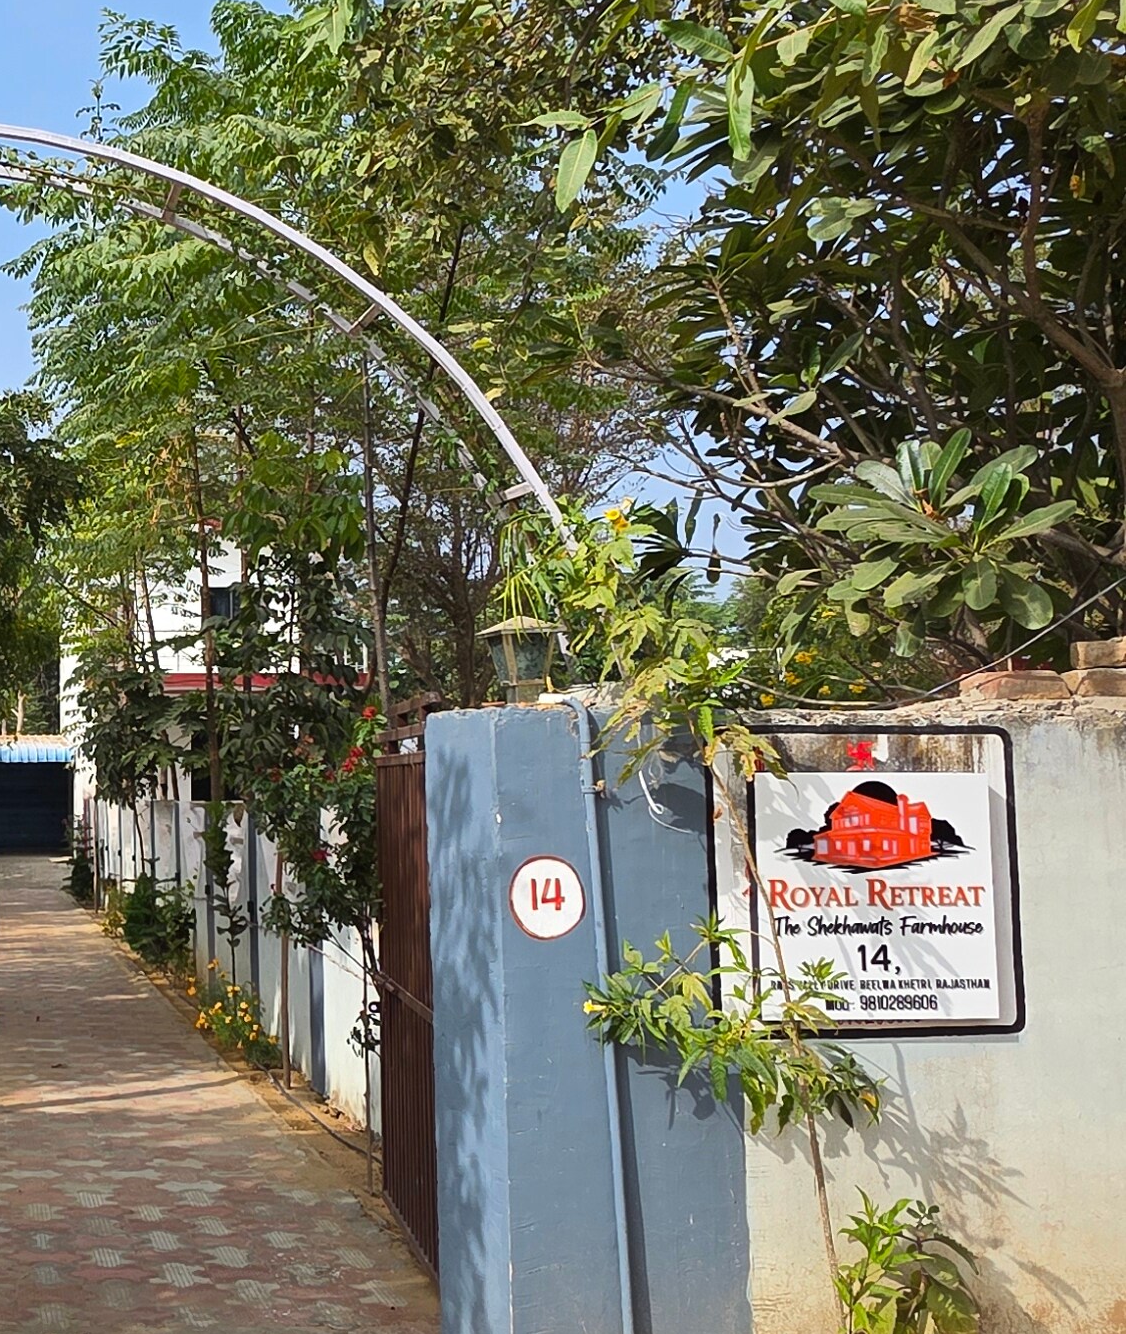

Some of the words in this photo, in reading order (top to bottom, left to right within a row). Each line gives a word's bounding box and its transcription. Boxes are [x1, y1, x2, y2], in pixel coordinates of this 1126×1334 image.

[530, 878, 565, 910] 14
[773, 915, 801, 937] The
[899, 915, 984, 936] Farmhouse
[935, 978, 991, 990] RAJASTHAN
[859, 994, 938, 1011] 9810289606
